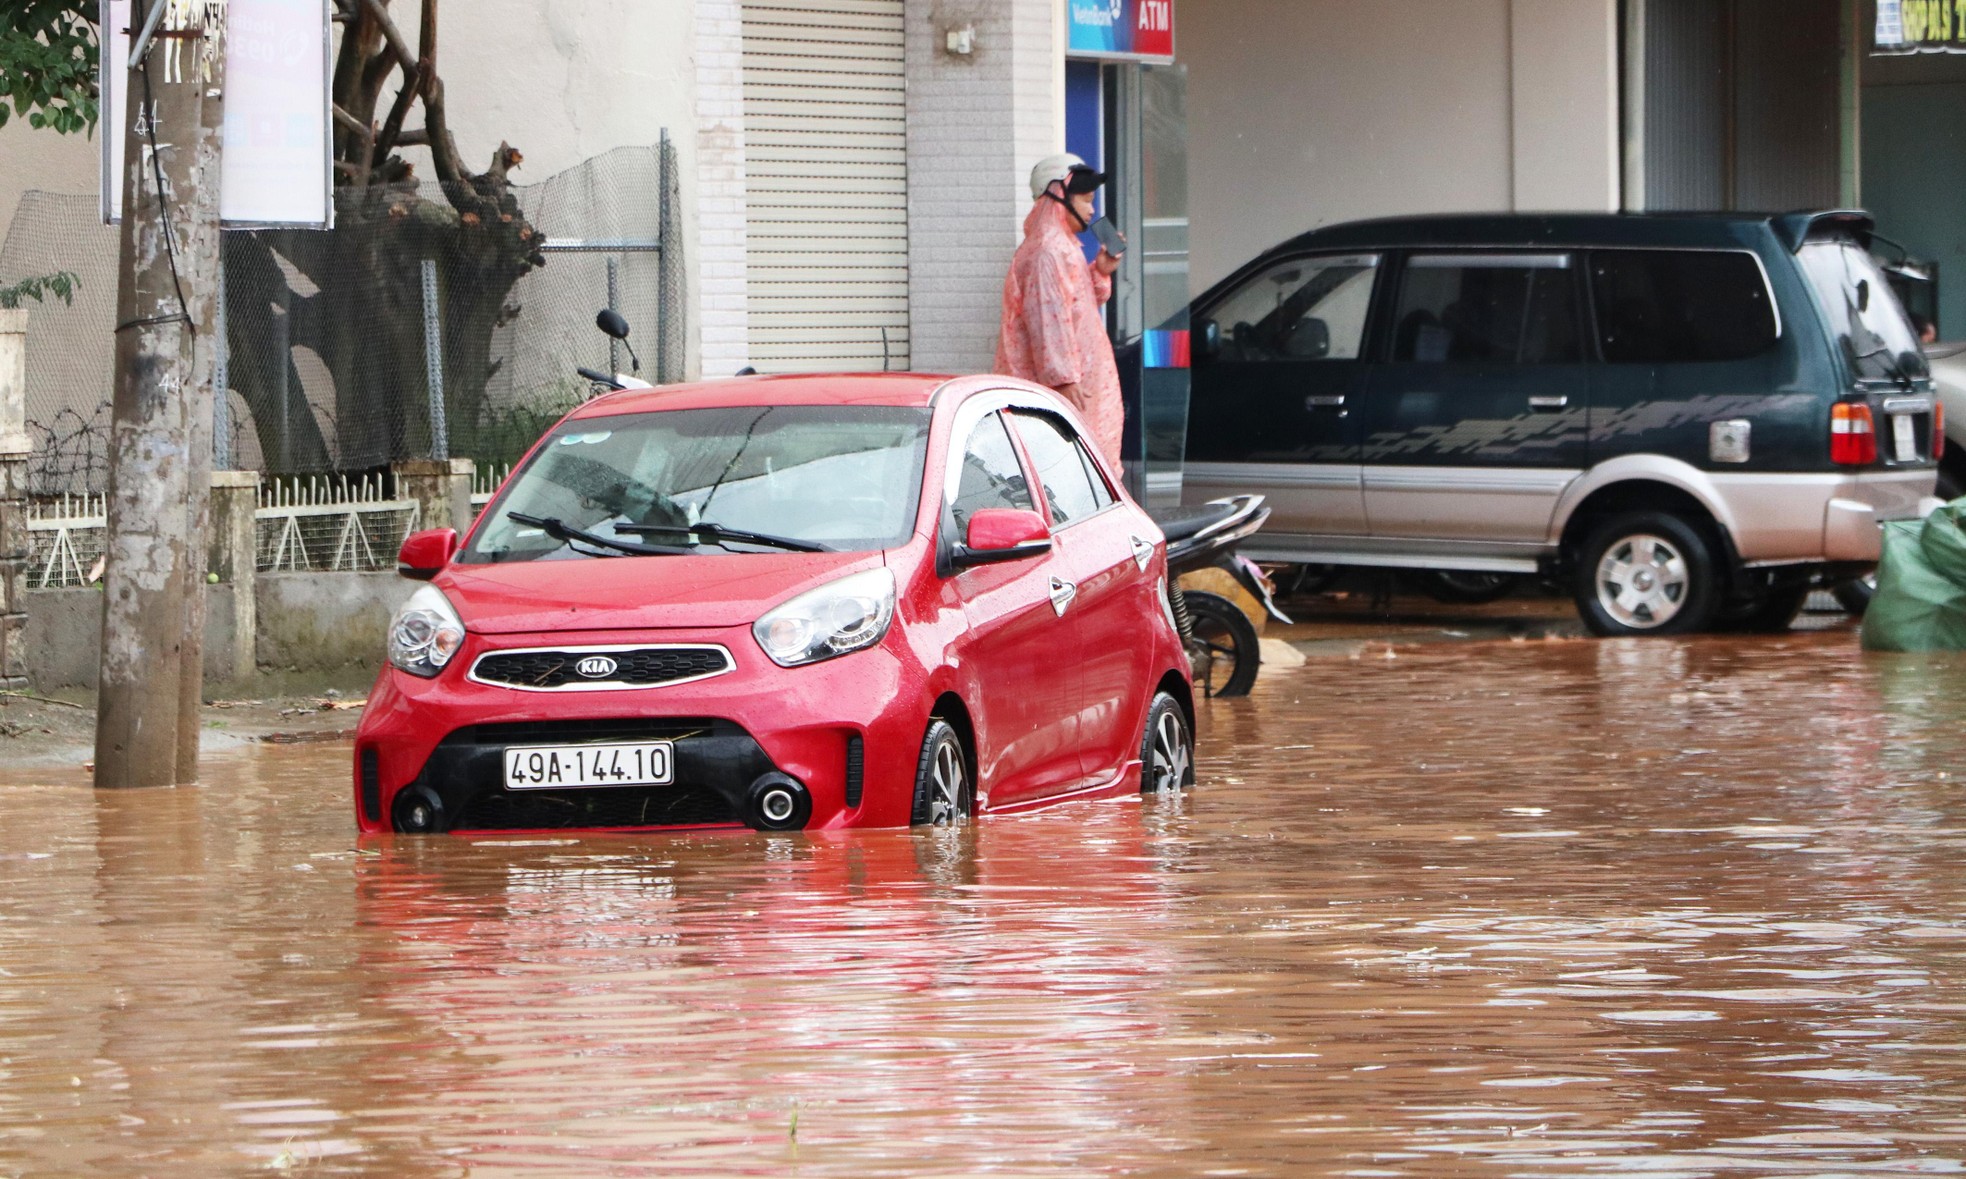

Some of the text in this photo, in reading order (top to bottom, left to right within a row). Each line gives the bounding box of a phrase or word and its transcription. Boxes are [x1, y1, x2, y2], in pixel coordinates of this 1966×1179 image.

[1138, 1, 1169, 31] ATM
[580, 660, 611, 673] KIA
[511, 748, 667, 784] 49A-144.10
